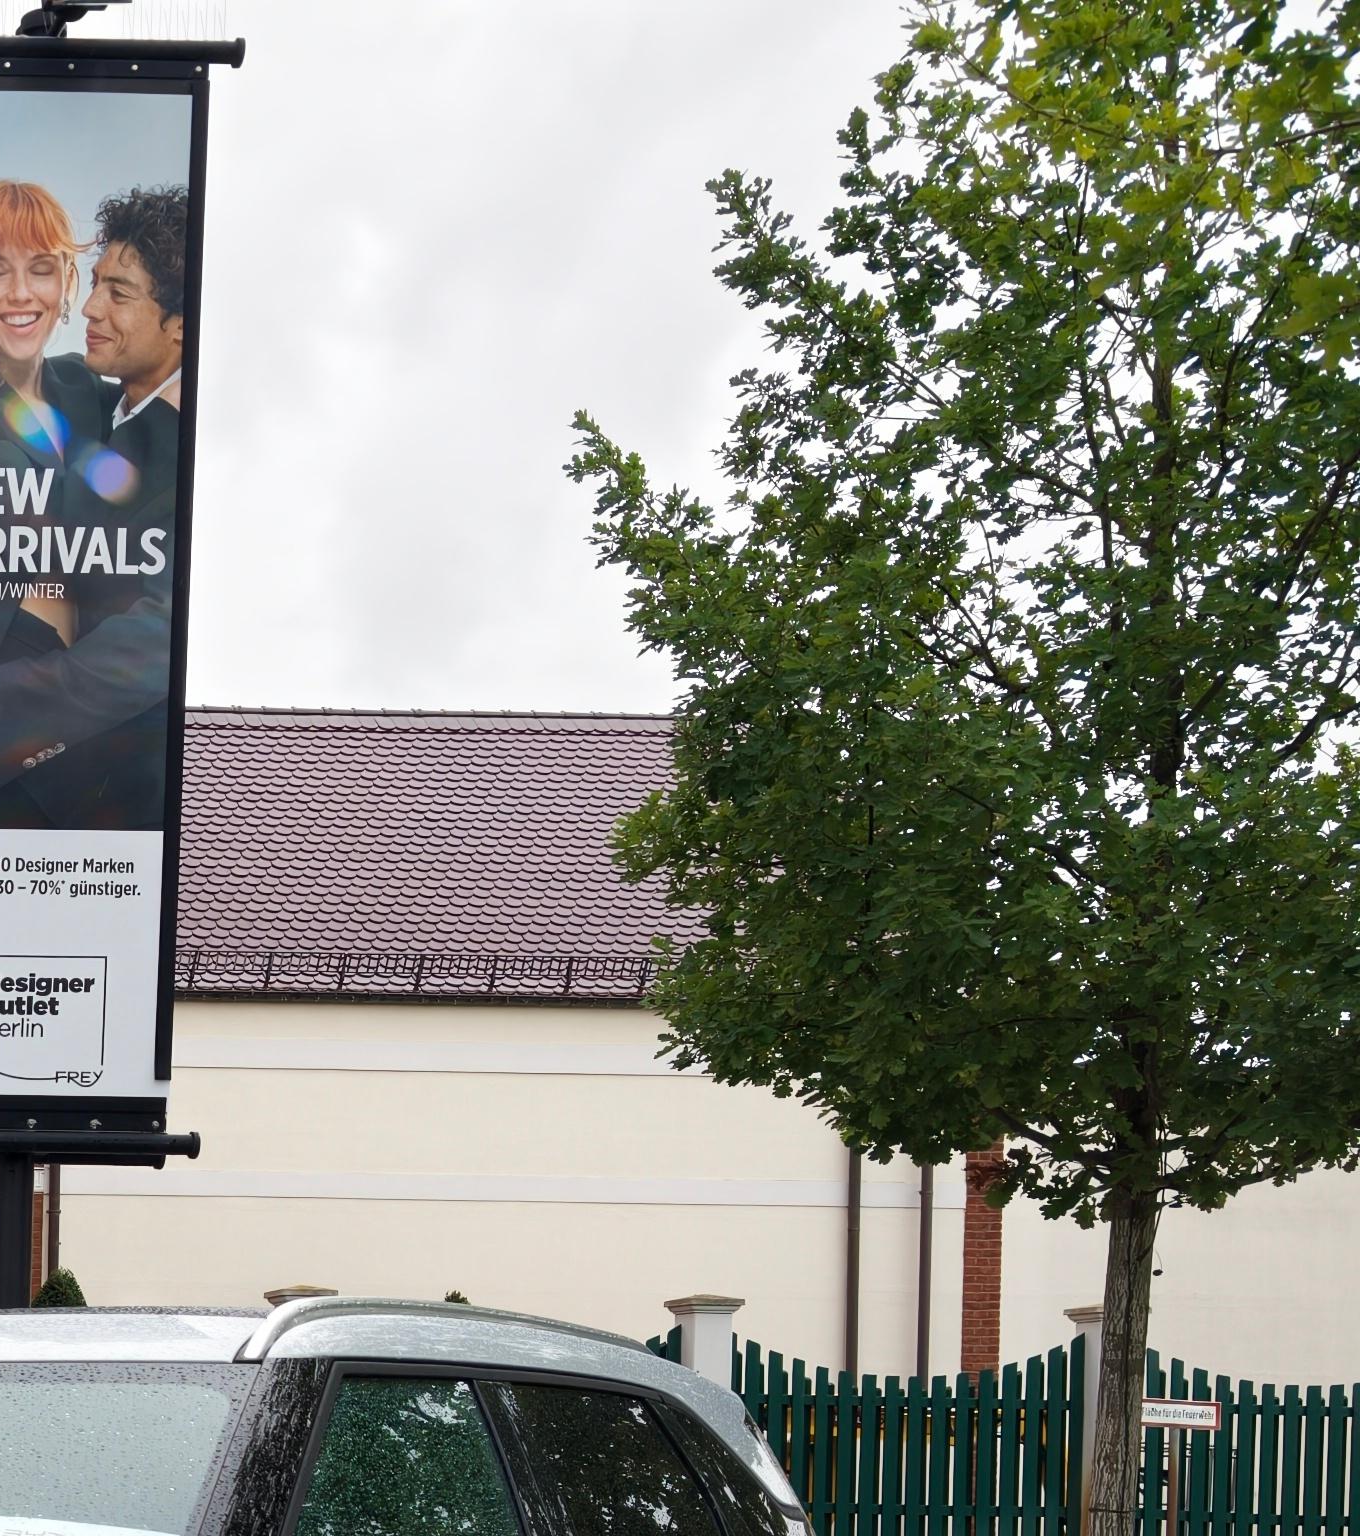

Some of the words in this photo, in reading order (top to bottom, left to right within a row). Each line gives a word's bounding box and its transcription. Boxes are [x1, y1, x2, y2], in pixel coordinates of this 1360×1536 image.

[15, 857, 79, 875] Designer
[82, 858, 134, 873] Marken
[69, 880, 141, 898] günstiger.
[55, 1070, 103, 1088] FREY
